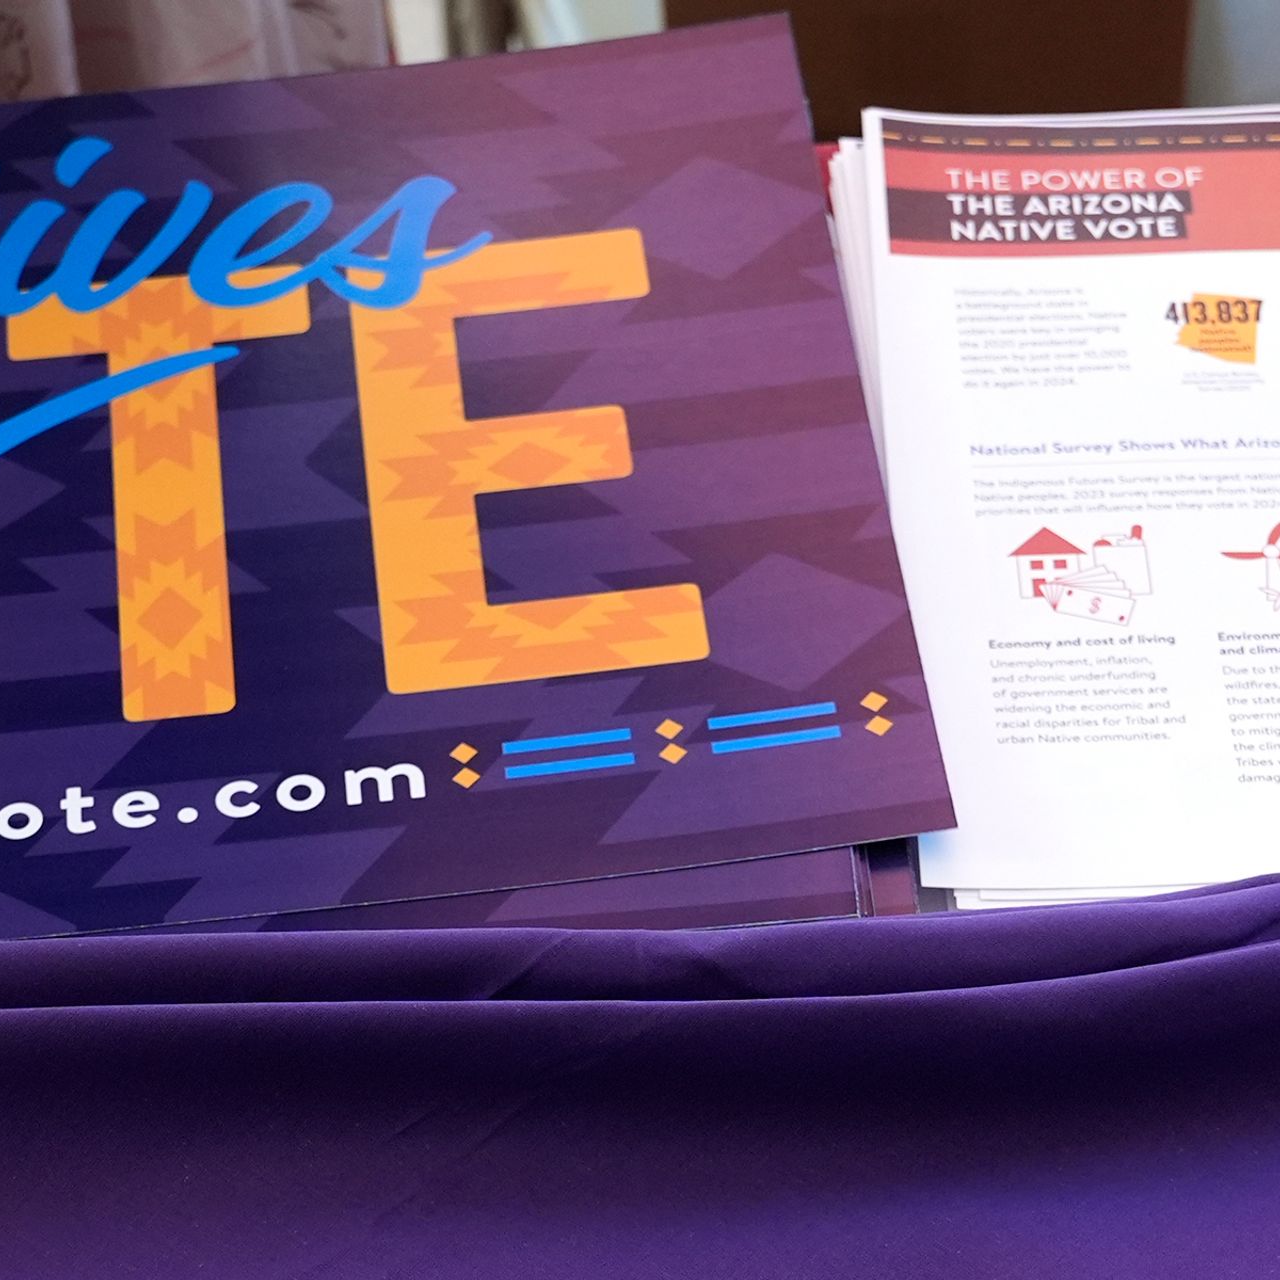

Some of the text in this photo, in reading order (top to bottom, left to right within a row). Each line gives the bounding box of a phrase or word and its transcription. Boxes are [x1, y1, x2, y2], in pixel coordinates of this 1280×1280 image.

[946, 167, 1204, 191] THE POWER OF
[946, 191, 1184, 218] THE ARIZONA
[949, 216, 1178, 242] NATIVE VOTE
[1165, 299, 1263, 325] 413,837
[969, 443, 1047, 457] National
[1051, 442, 1113, 456] Survey
[1118, 440, 1176, 453] Shows
[1180, 438, 1228, 451] What
[987, 634, 1176, 651] Economy and cost of living
[1218, 645, 1245, 656] and
